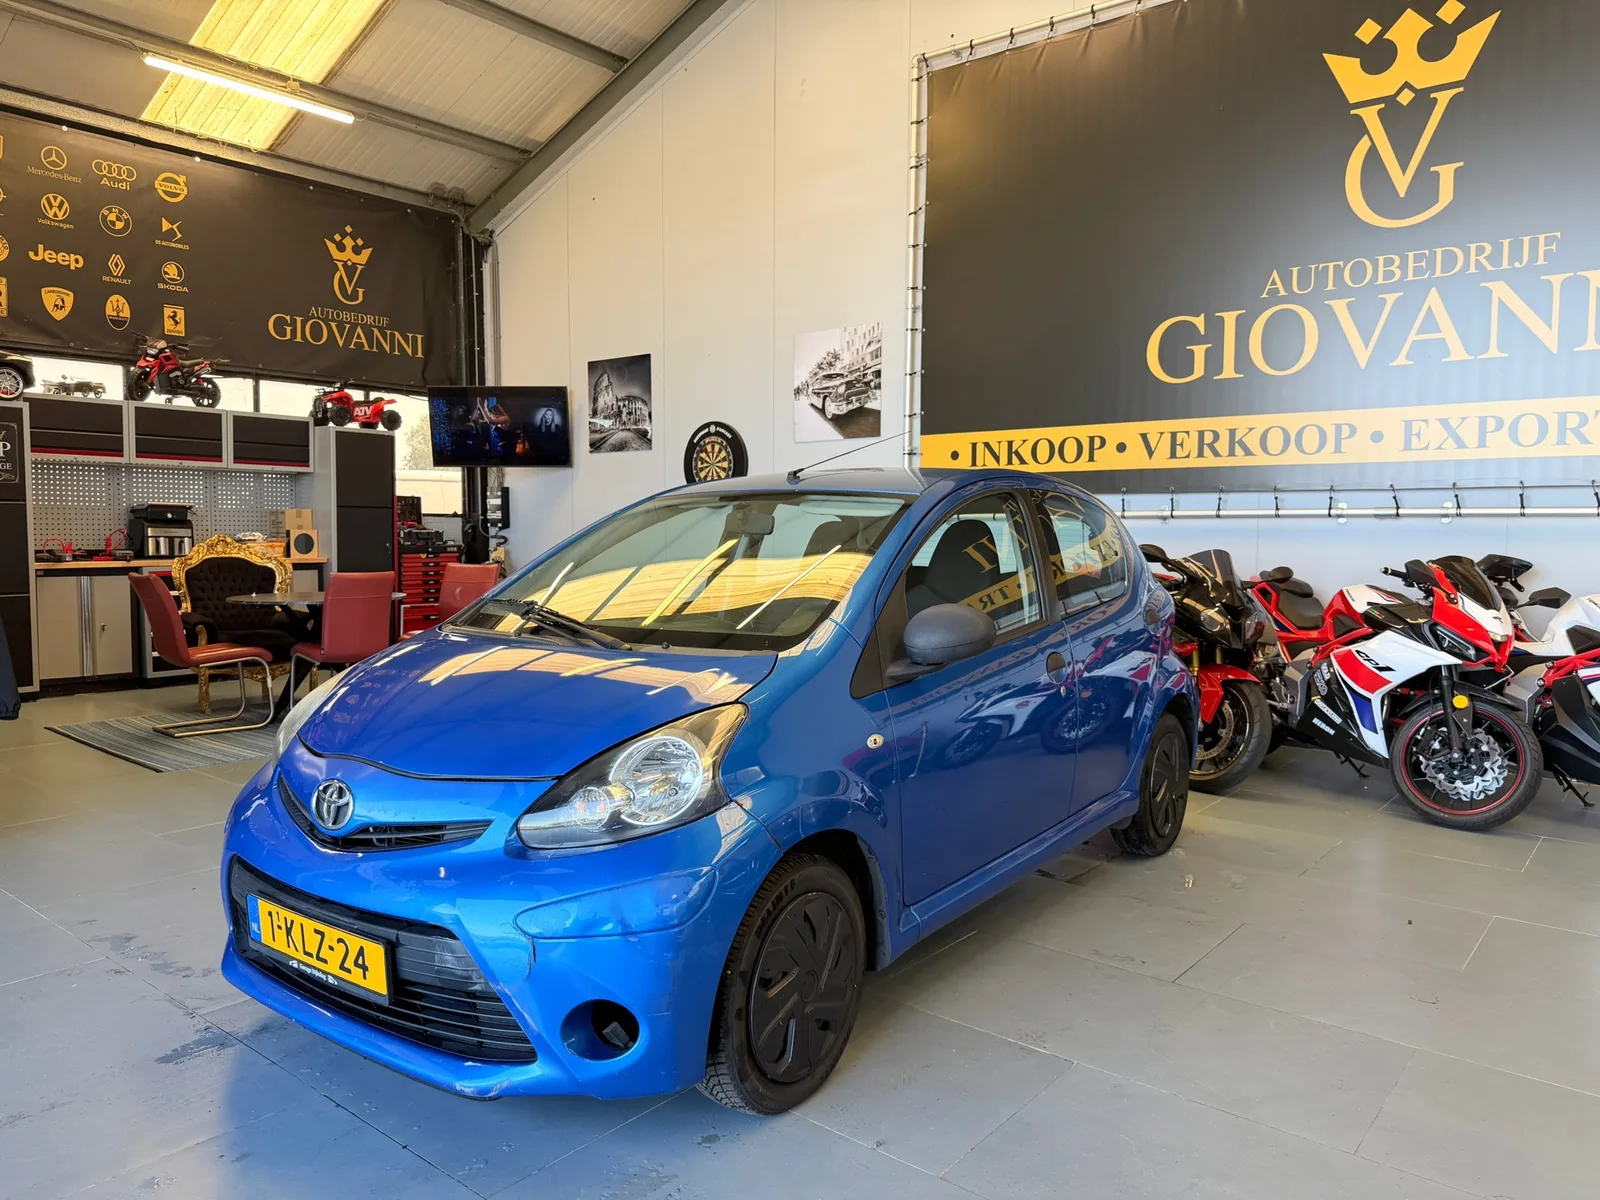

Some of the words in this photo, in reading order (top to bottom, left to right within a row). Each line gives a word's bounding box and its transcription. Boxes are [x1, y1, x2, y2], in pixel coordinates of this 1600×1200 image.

[26, 165, 83, 184] Mercedes-Benz
[100, 177, 130, 191] Audi
[158, 183, 185, 193] VOLVO
[37, 217, 75, 230] Volkswagen
[28, 243, 84, 270] Jeep
[1260, 231, 1562, 299] AUTOBEDRIJF
[102, 275, 132, 285] RENAULT
[308, 305, 390, 328] AUTOBEDRIJF
[267, 312, 425, 359] GIOVANNI
[1145, 270, 1600, 384] GIOVAN
[353, 405, 372, 417] ATV
[968, 434, 1107, 468] INKOOP
[1137, 422, 1358, 461] VERKOOP
[1398, 409, 1600, 453] EXPOR
[251, 921, 261, 934] NL
